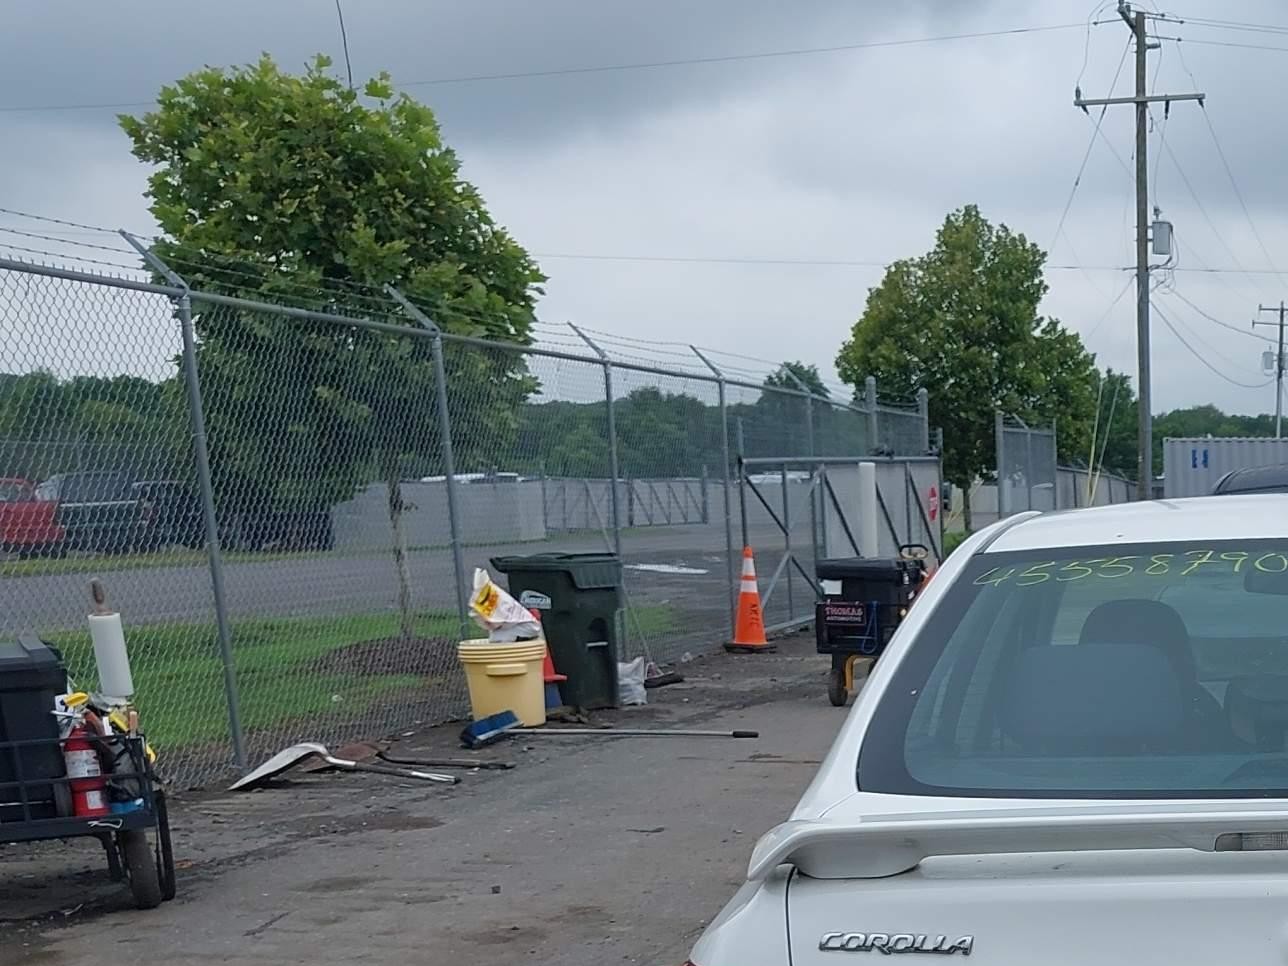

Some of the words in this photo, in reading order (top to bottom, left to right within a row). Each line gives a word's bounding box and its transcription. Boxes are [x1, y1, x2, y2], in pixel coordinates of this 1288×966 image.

[972, 550, 1288, 588] 45558790
[825, 606, 863, 616] THOMAS
[819, 932, 974, 955] COROLLA
